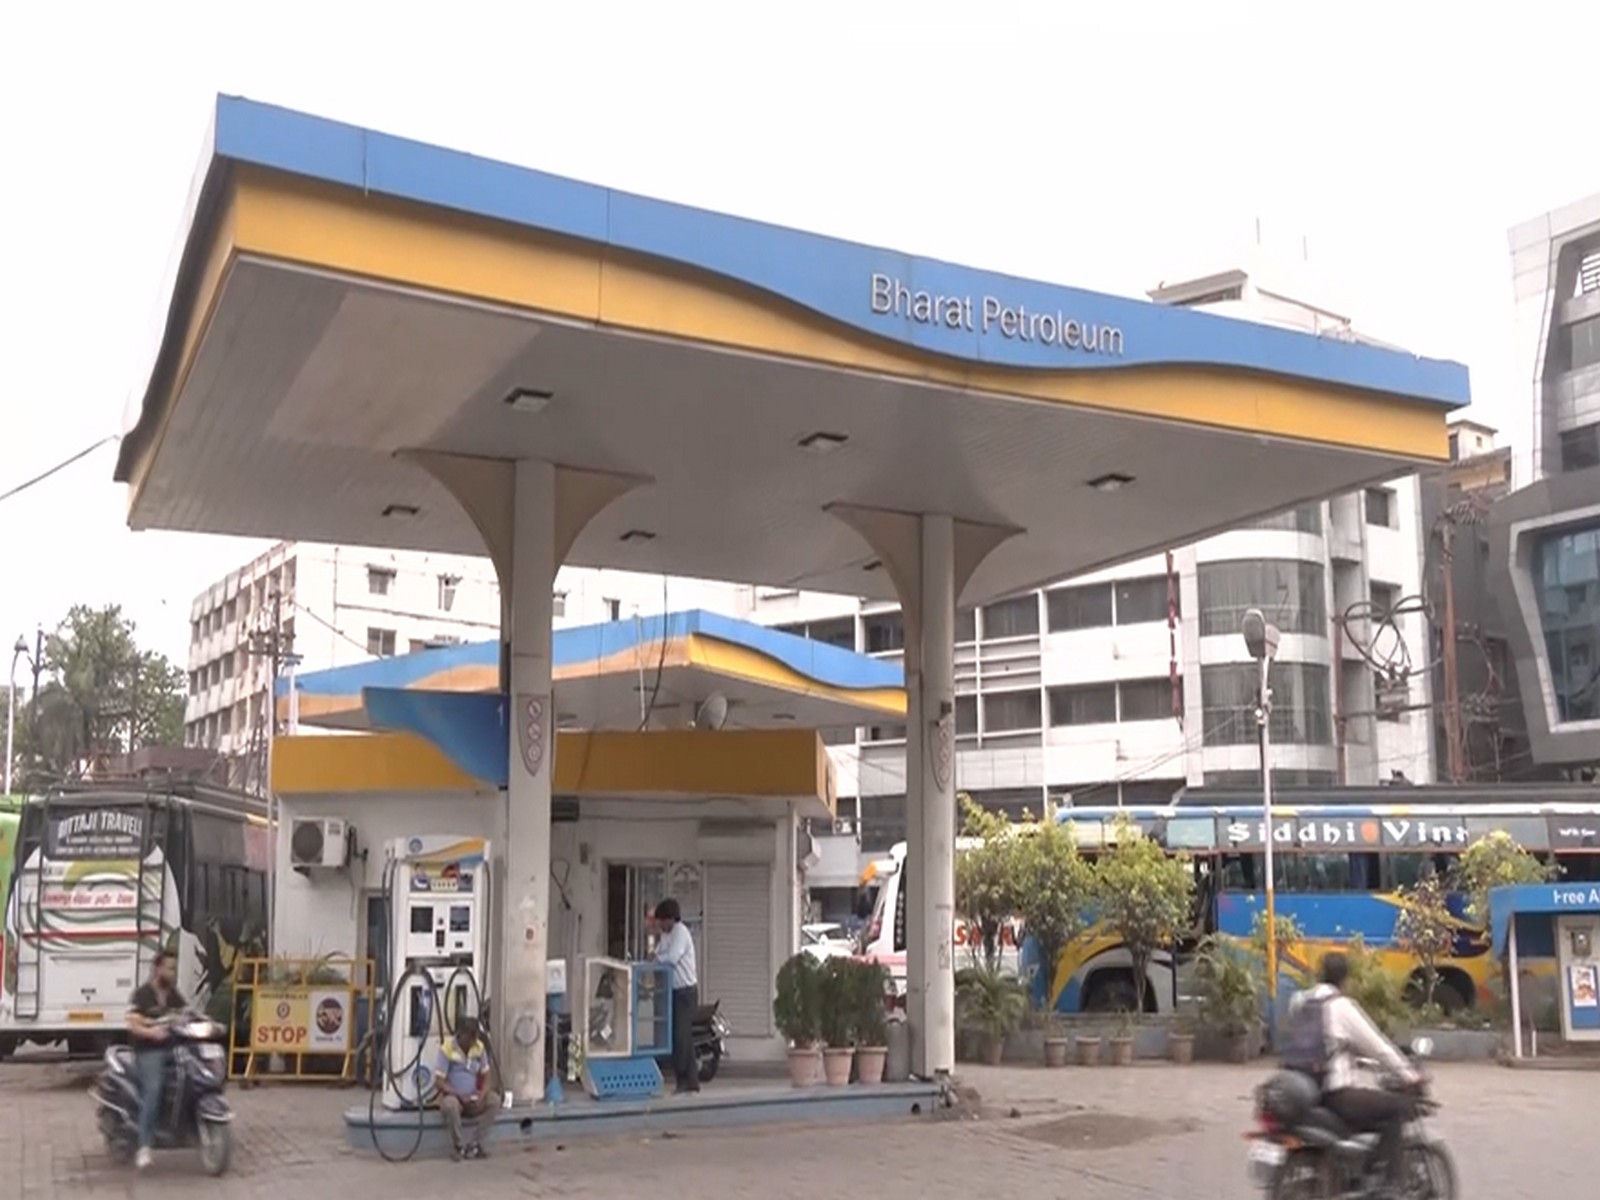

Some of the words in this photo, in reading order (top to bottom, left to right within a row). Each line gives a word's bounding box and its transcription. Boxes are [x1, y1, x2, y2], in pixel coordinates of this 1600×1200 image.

[871, 273, 974, 331] Bharat
[982, 295, 1124, 354] Petroleum
[1227, 822, 1356, 844] Siddhi
[1553, 889, 1586, 904] Free
[257, 1026, 307, 1044] STOP
